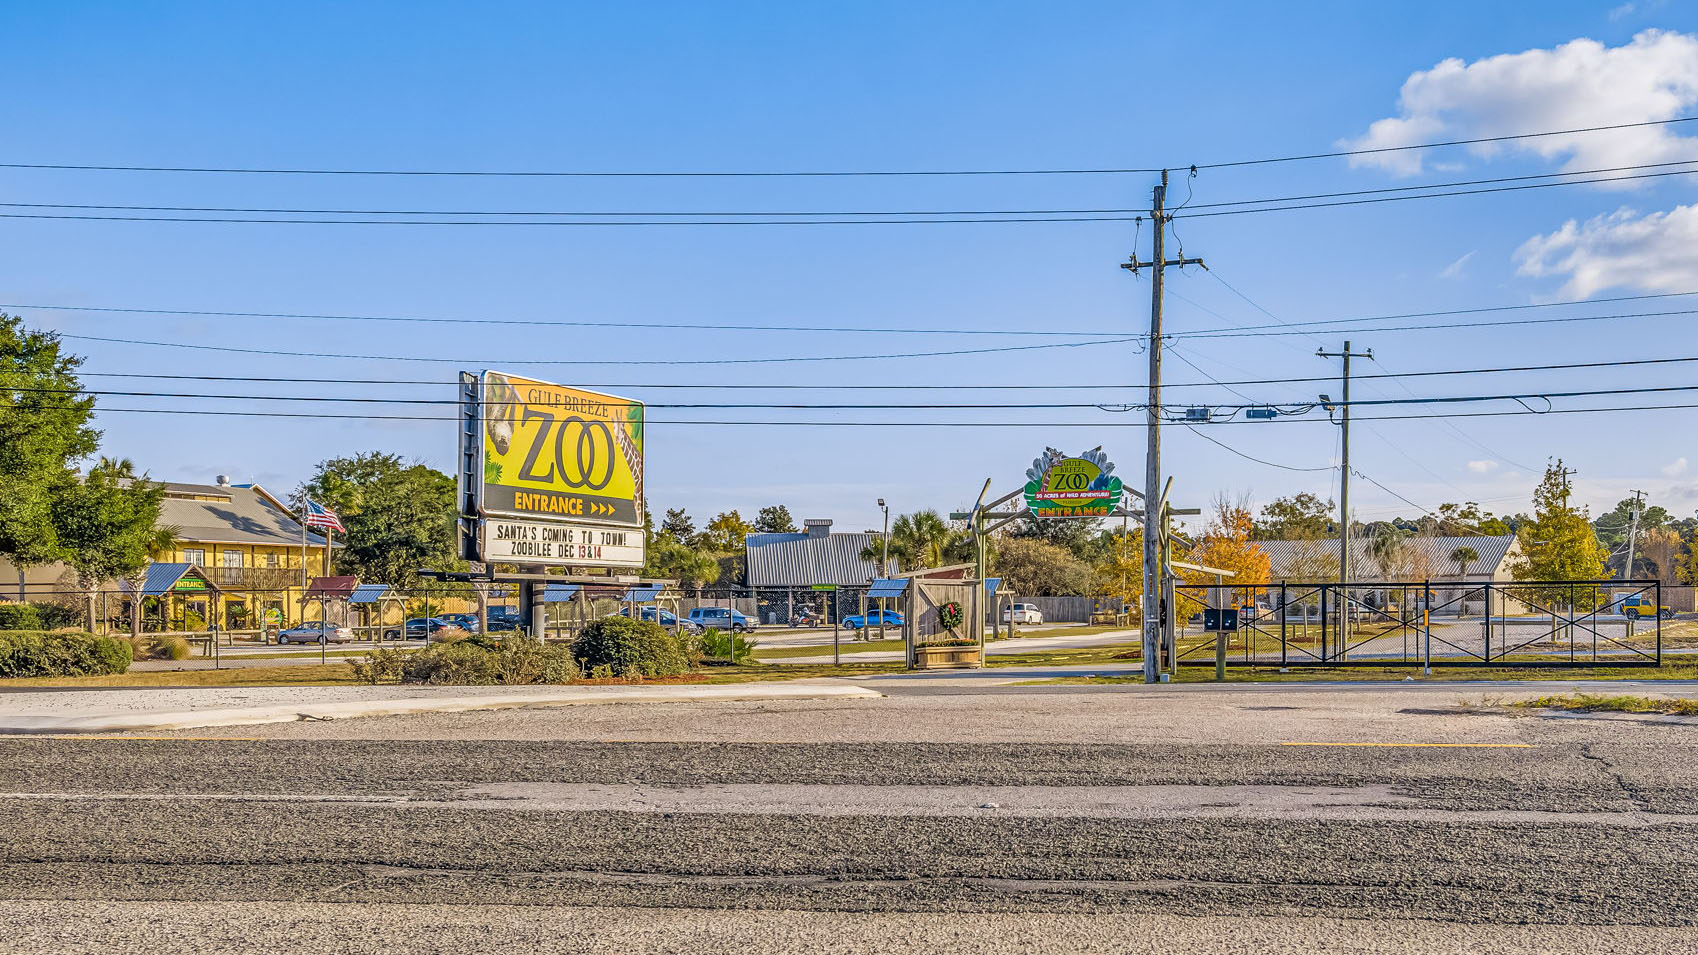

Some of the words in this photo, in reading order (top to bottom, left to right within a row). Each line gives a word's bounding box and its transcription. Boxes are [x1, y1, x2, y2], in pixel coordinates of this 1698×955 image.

[528, 388, 561, 406] GULF
[564, 395, 608, 418] BREEZE
[518, 402, 615, 491] ZOO
[1054, 473, 1089, 490] ZOO
[515, 492, 583, 515] ENTRANCE
[1038, 507, 1108, 516] ENTRANCE
[497, 525, 537, 540] SANTA'S
[542, 527, 573, 543] COMING
[582, 531, 592, 544] TO
[511, 542, 551, 557] ZOOBILEE
[558, 545, 574, 558] DEC
